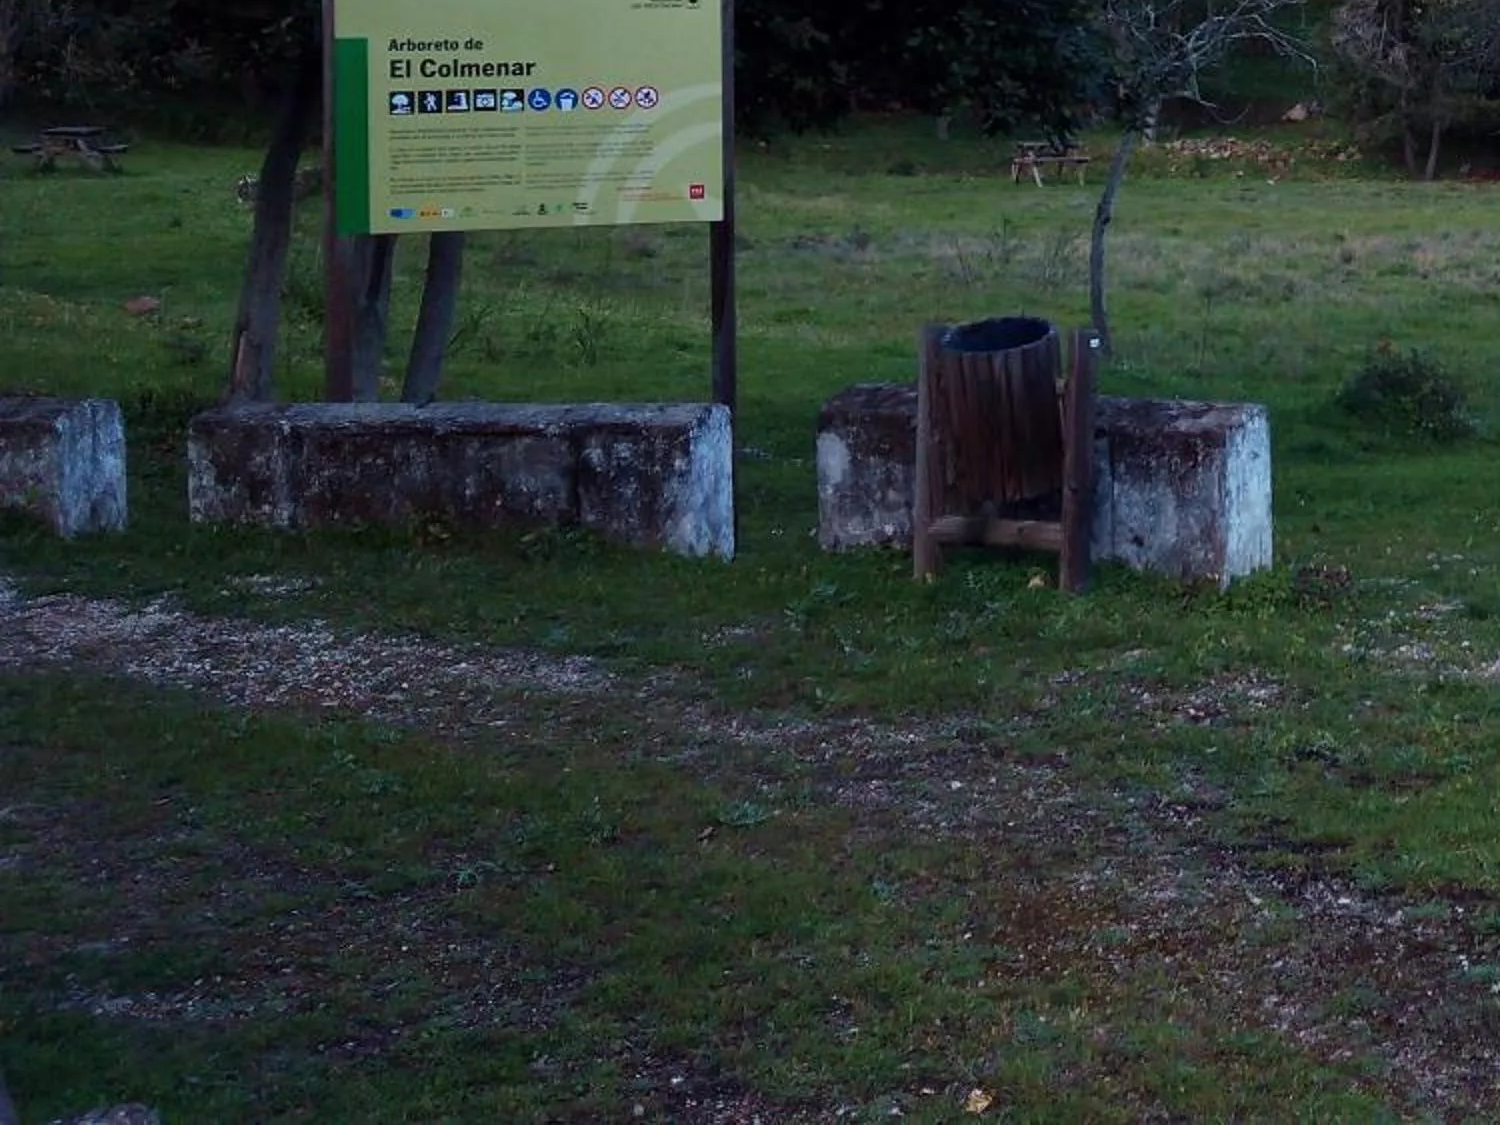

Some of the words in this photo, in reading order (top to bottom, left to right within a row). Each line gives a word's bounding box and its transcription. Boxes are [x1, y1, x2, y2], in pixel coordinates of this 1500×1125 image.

[389, 38, 459, 51] Arboreto
[464, 36, 483, 50] de
[390, 59, 411, 78] El
[420, 57, 536, 77] Colmenar
